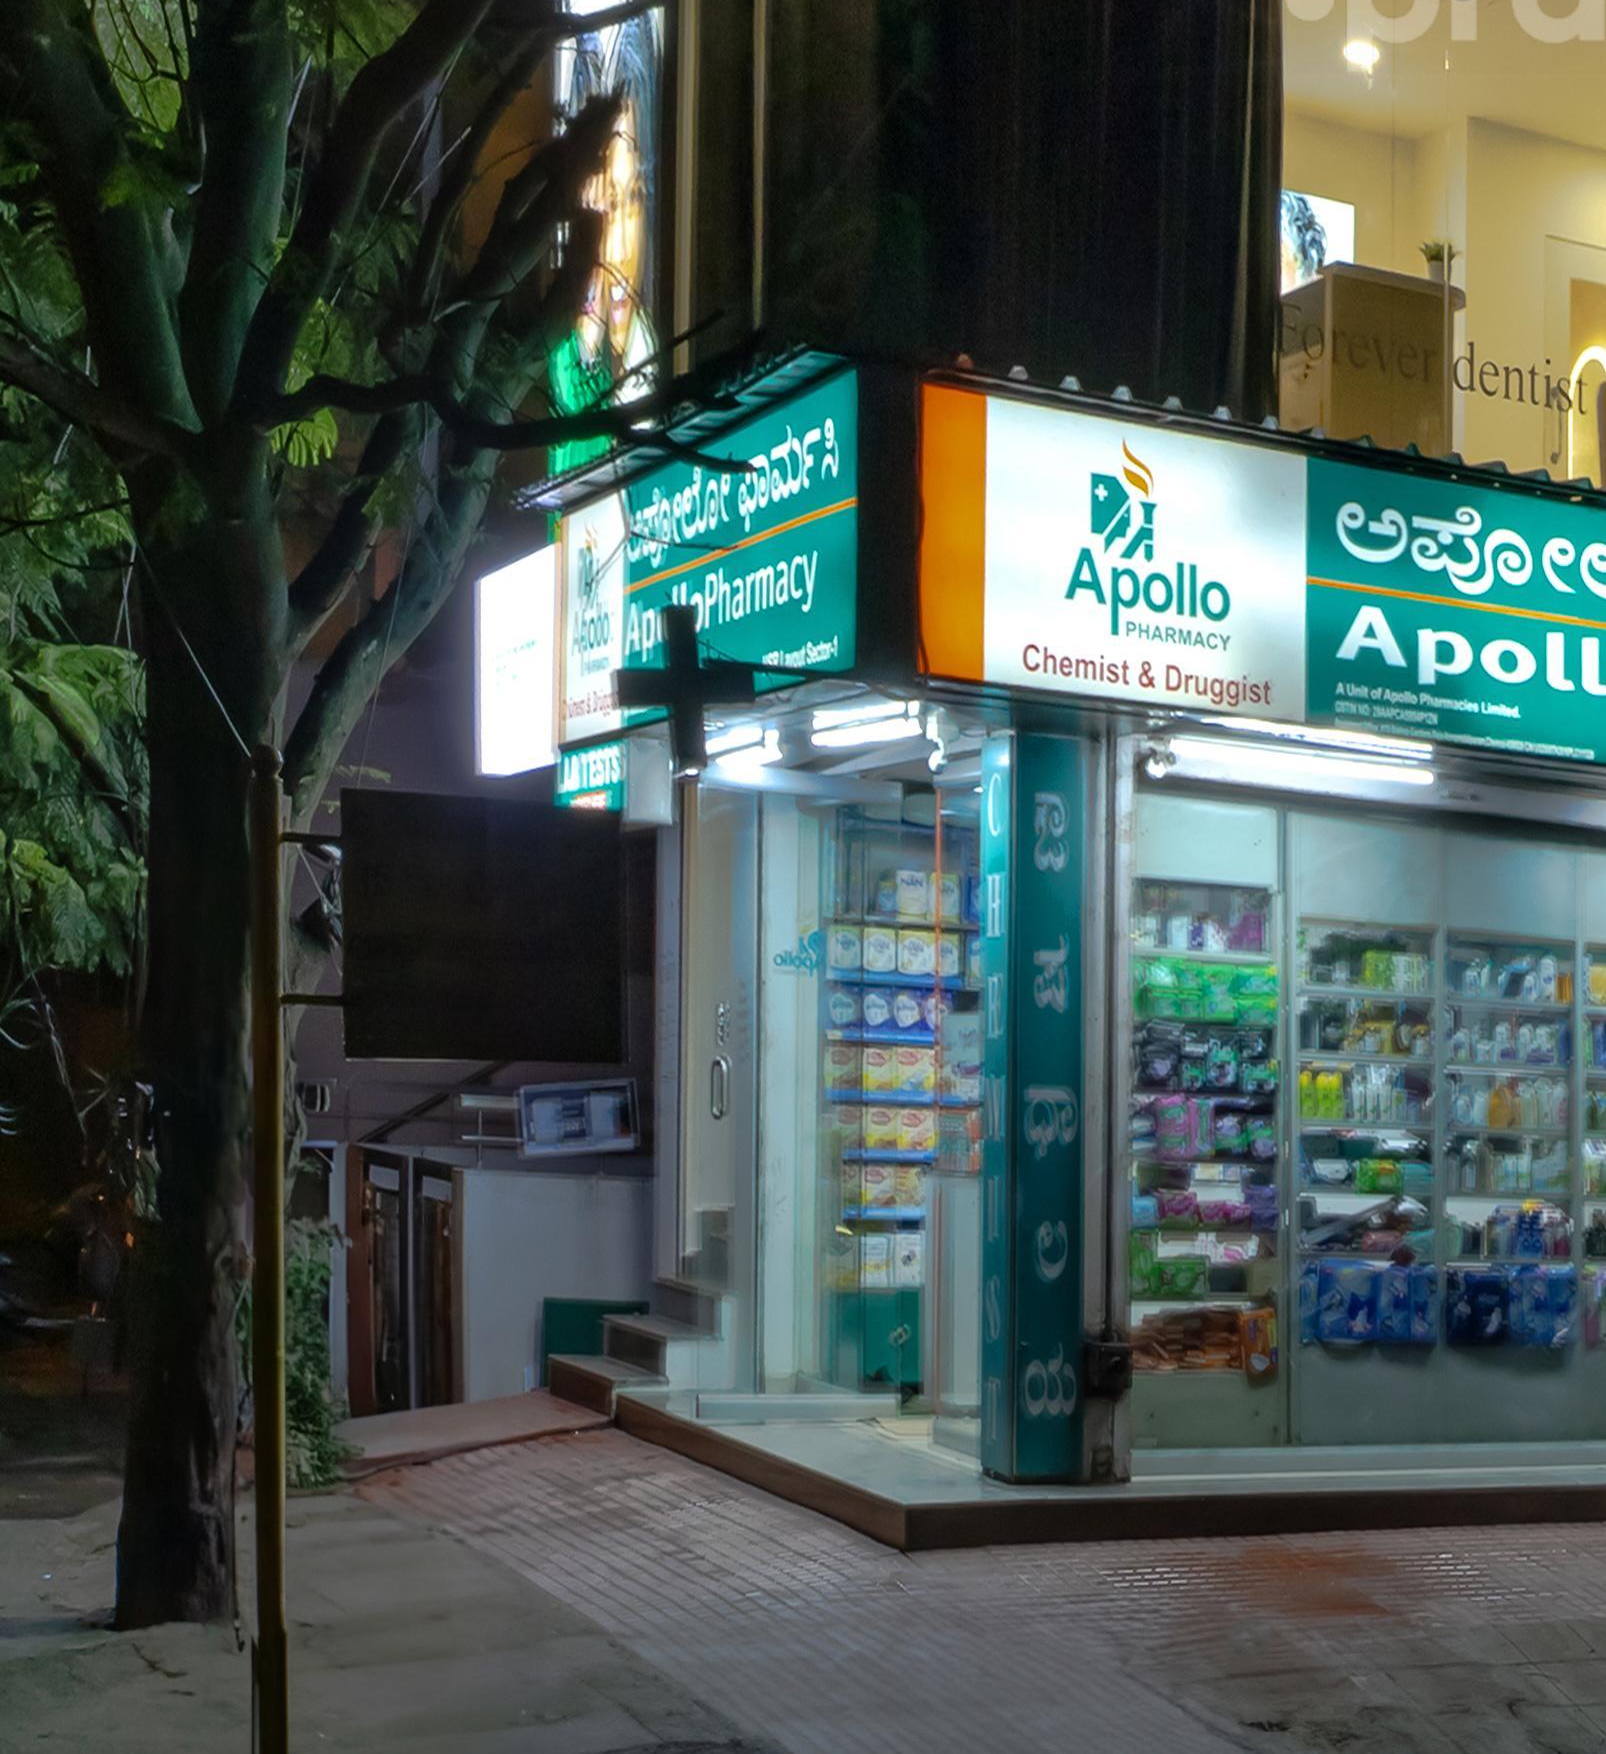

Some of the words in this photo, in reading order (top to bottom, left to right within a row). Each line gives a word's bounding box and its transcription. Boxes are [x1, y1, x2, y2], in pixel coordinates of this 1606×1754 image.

[1453, 341, 1588, 415] dentist
[1064, 547, 1231, 635] Apollo
[1126, 620, 1232, 651] PHARMACY
[1022, 643, 1130, 686] Chemist
[1138, 660, 1156, 689] &
[1164, 664, 1272, 707] Druggist
[1335, 681, 1345, 695] A
[1346, 683, 1369, 699] Unit
[1371, 686, 1382, 700] of
[1383, 688, 1418, 706] Apollo
[1420, 693, 1479, 713] Pharmacies
